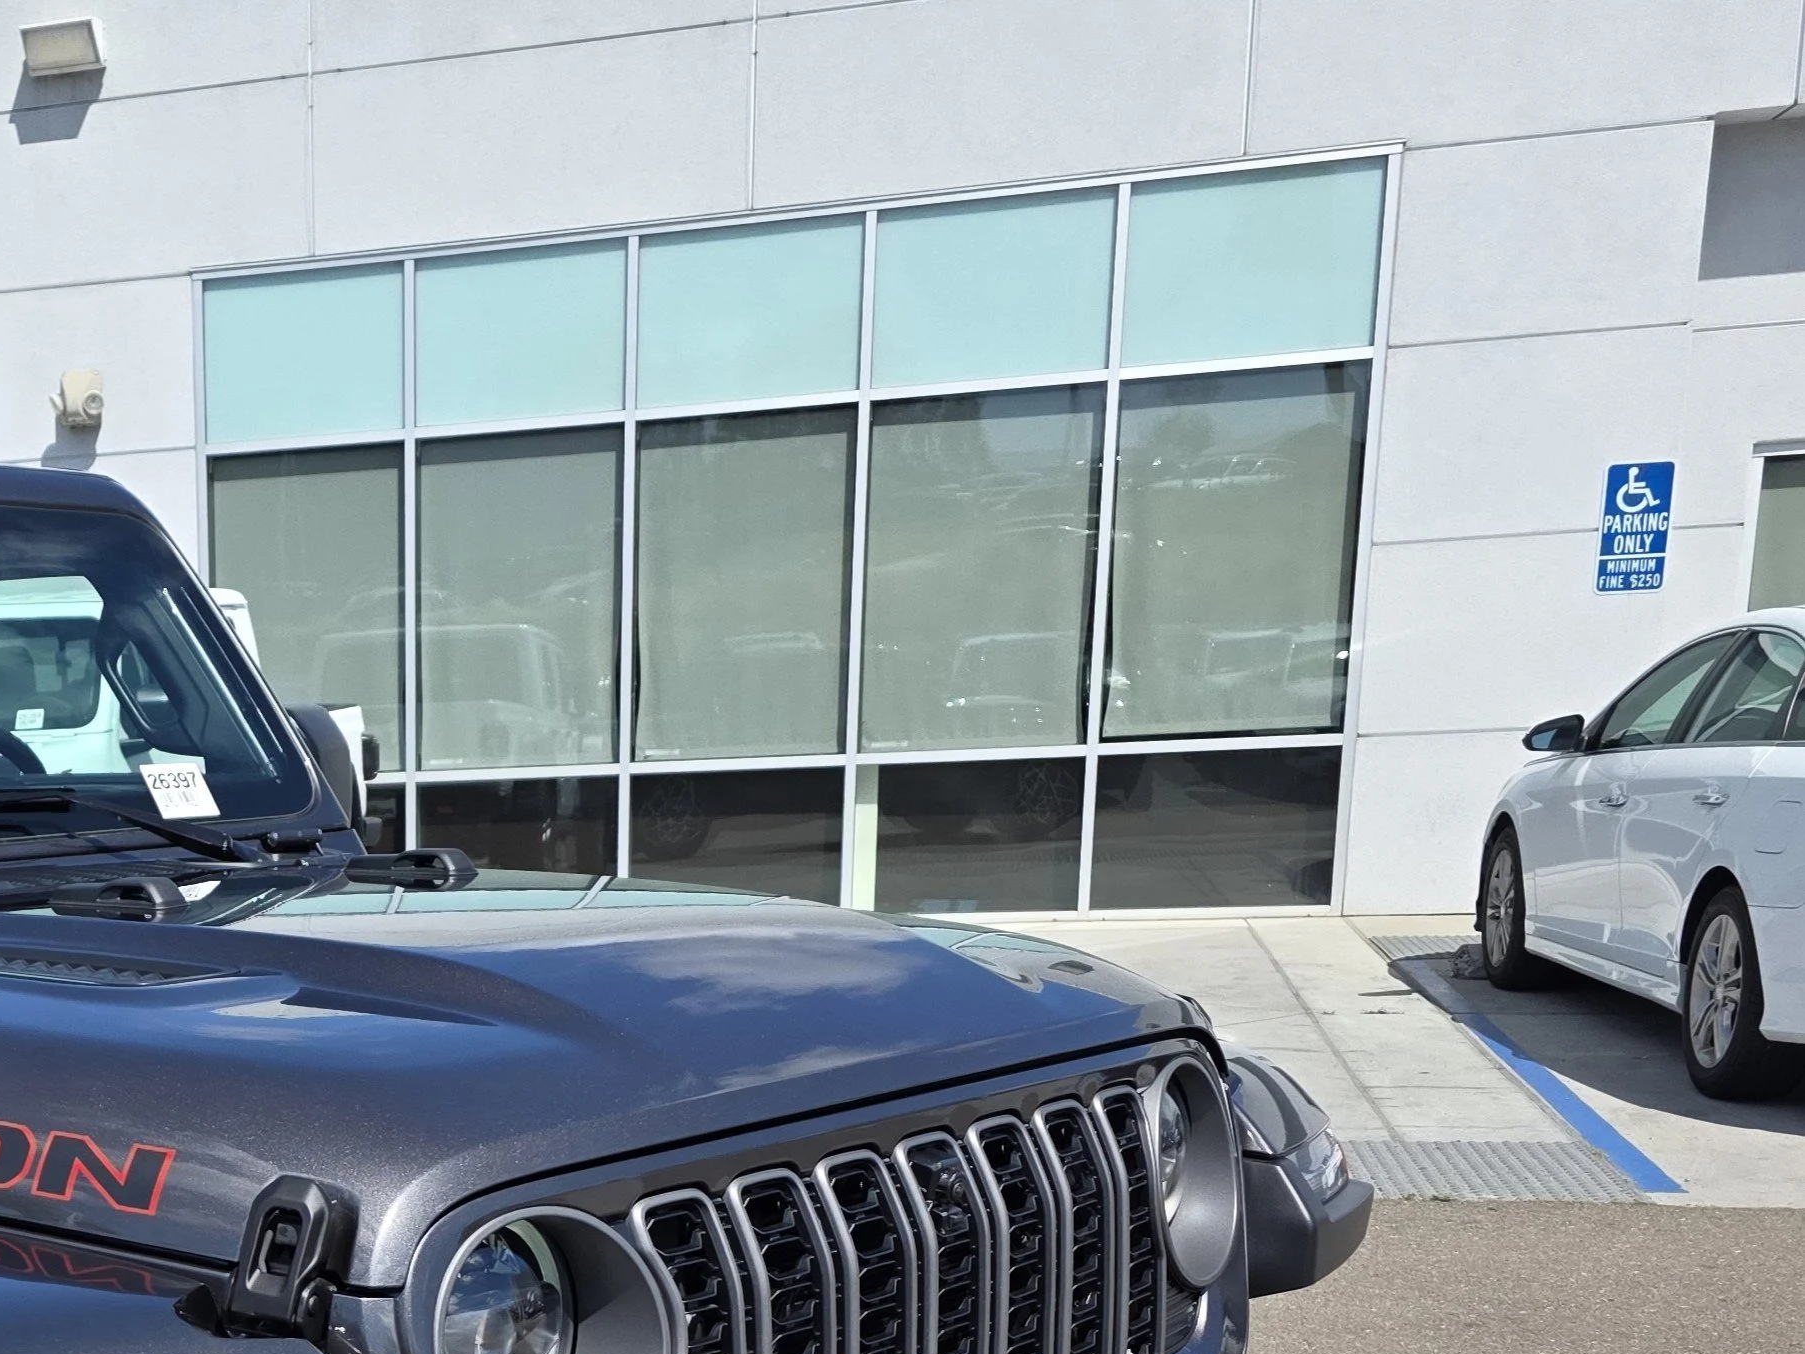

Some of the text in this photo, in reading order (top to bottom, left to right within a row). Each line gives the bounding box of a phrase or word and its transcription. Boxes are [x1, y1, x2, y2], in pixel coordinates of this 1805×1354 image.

[1603, 512, 1668, 534] PARKING
[1613, 534, 1654, 554] ONLY
[1606, 559, 1656, 573] MINIMUM
[1599, 573, 1661, 589] FINE $250
[148, 772, 197, 790] 26397
